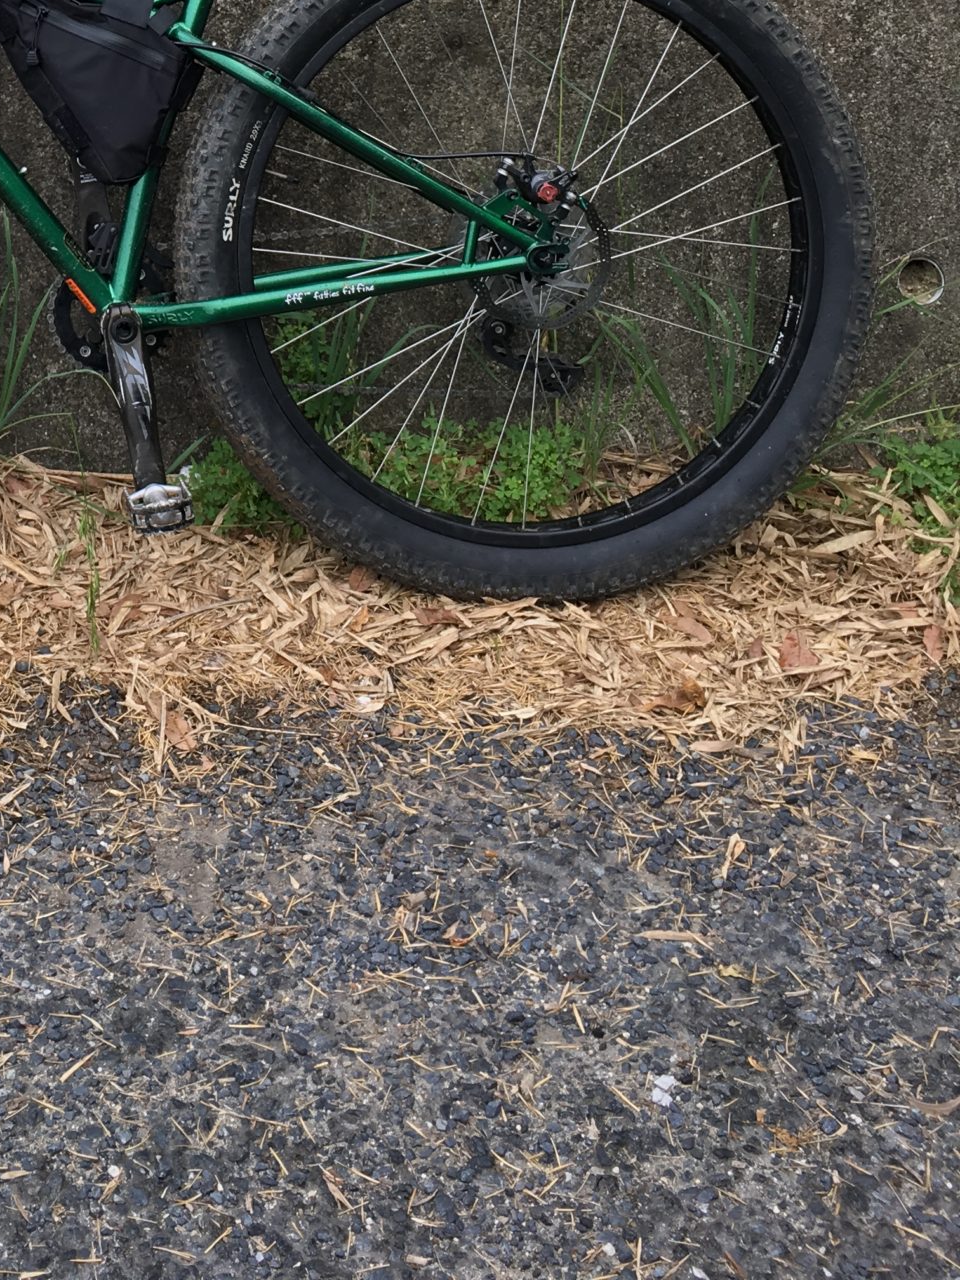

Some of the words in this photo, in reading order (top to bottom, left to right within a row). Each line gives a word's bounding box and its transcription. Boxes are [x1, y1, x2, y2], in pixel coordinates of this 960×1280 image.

[223, 178, 241, 242] SURLY
[238, 142, 253, 169] KNARD
[147, 310, 194, 324] SURLY
